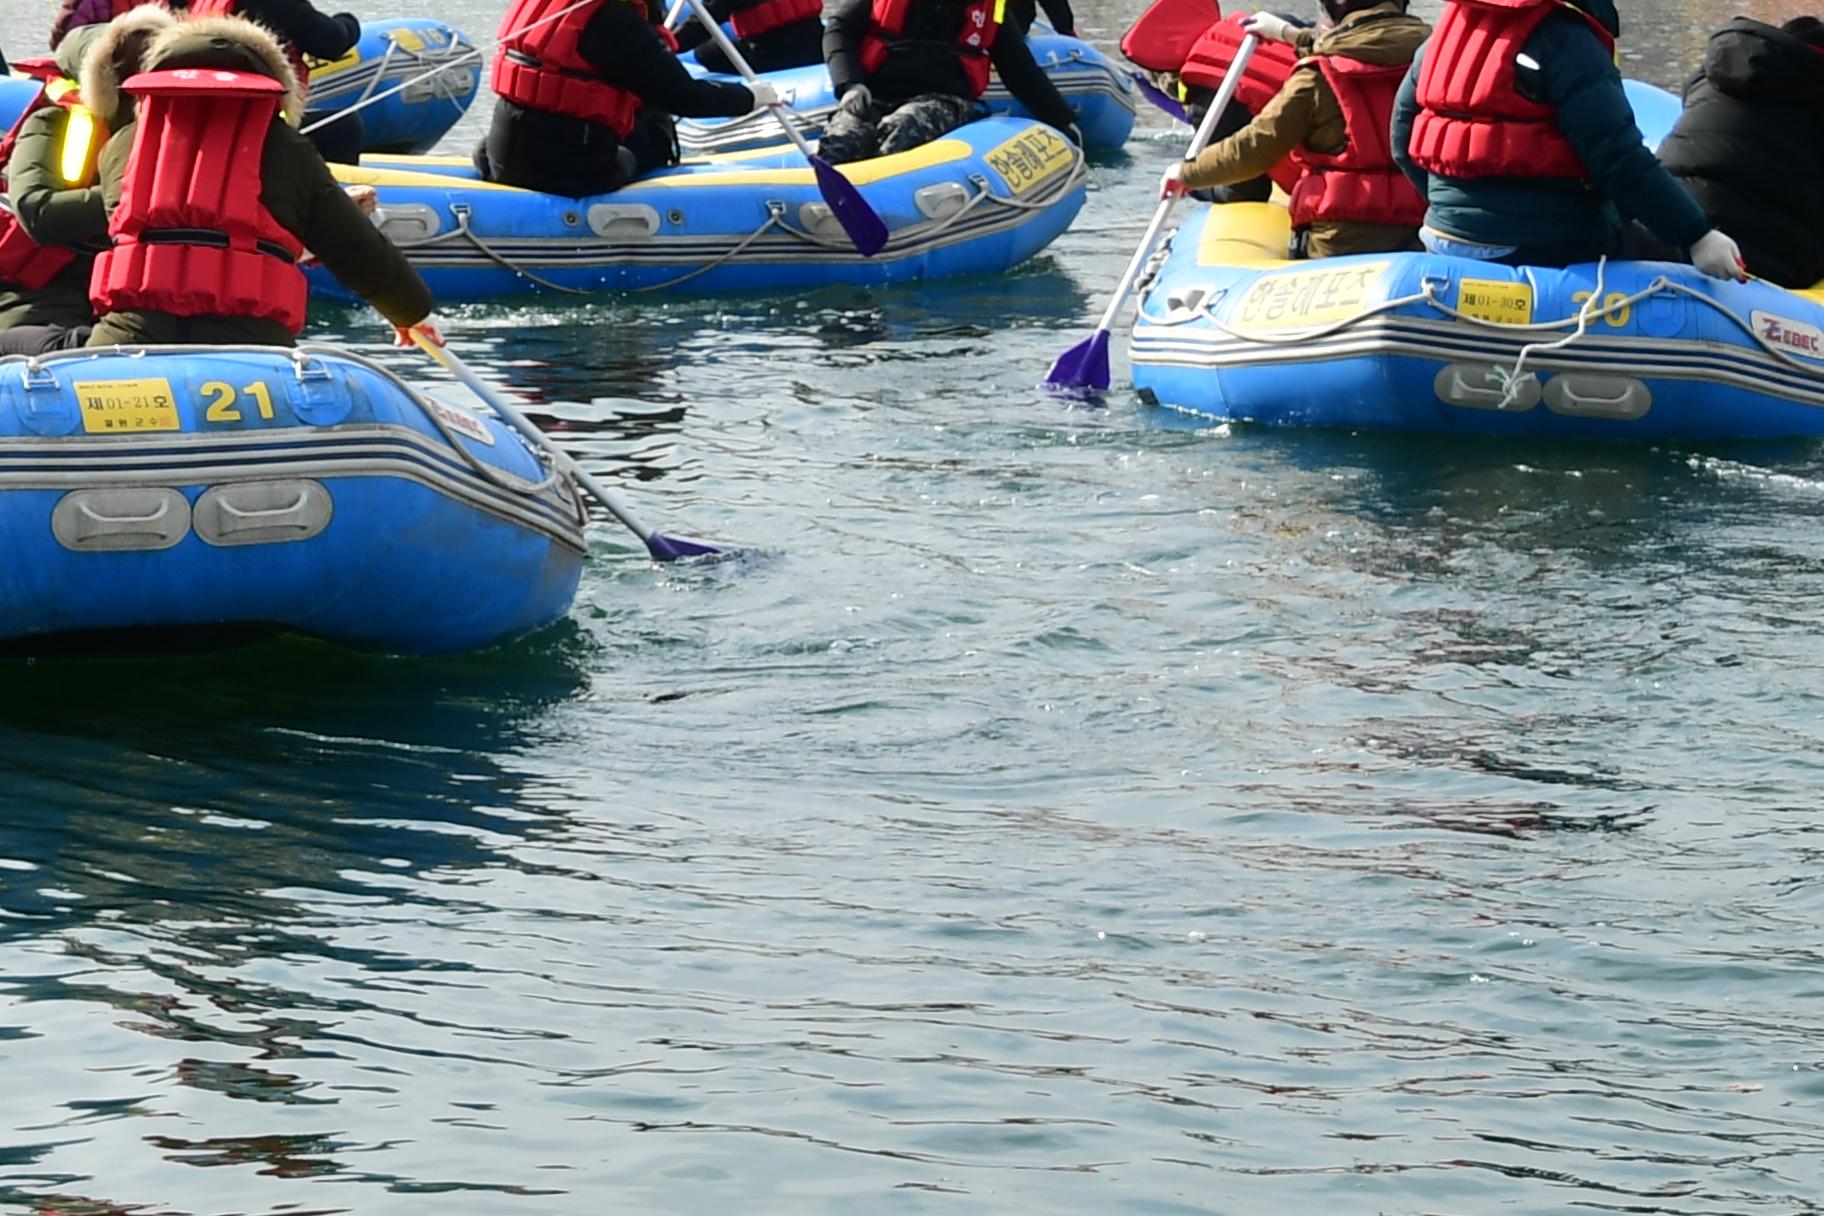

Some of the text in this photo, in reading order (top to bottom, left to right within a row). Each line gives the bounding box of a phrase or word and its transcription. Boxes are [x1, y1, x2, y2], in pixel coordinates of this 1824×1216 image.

[1571, 291, 1632, 328] 30
[1762, 317, 1818, 351] ZEBEC
[201, 381, 274, 422] 21
